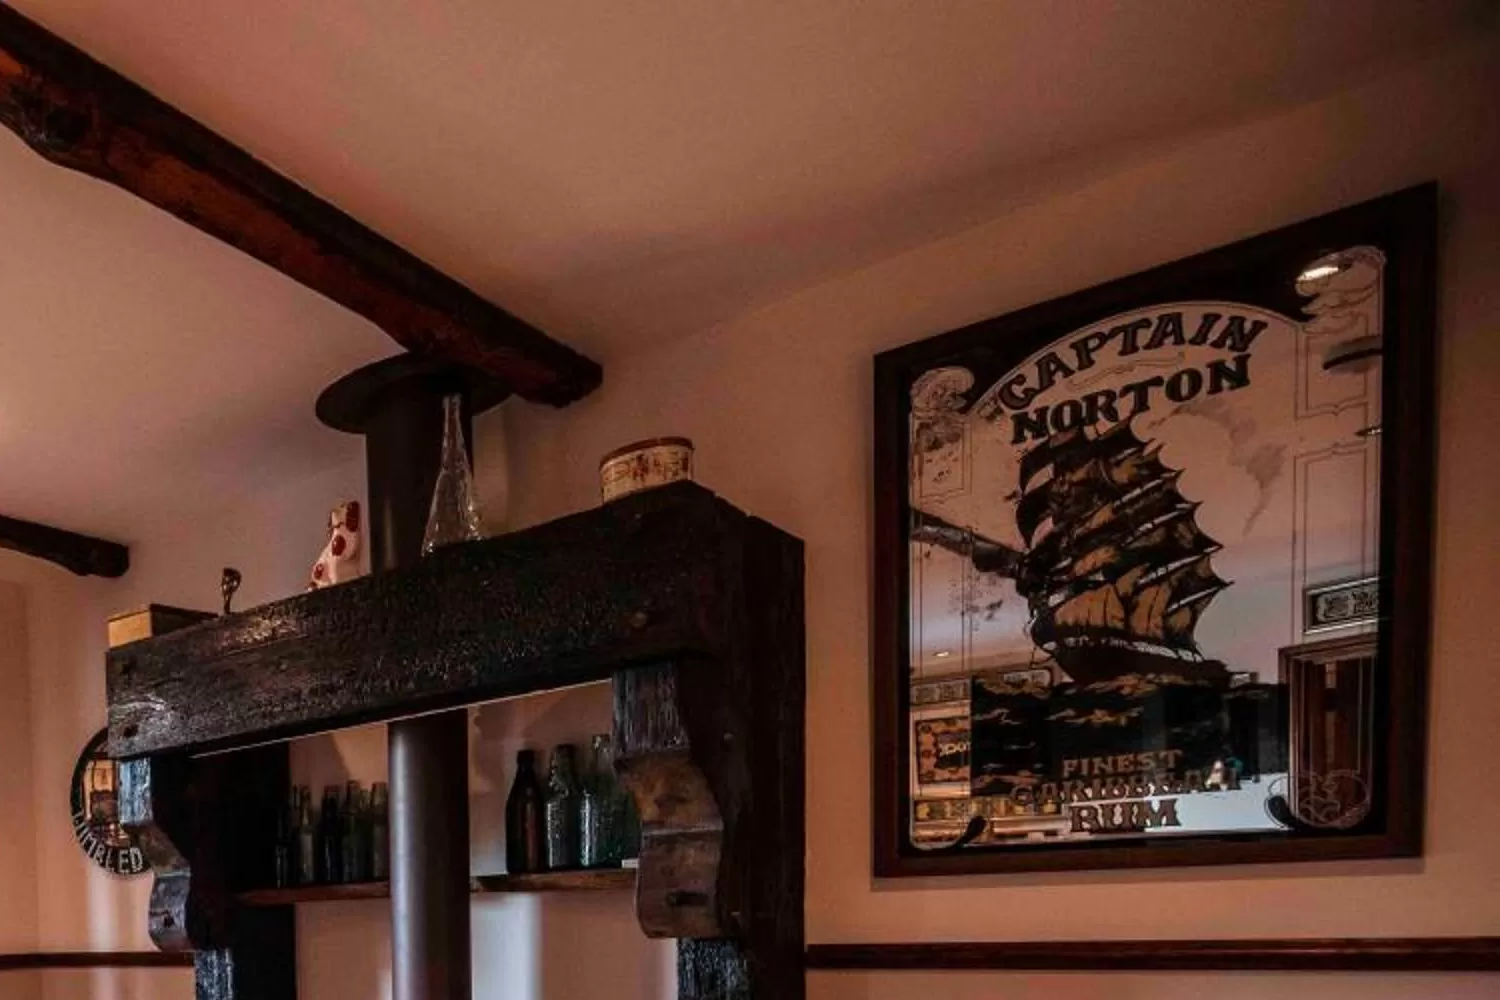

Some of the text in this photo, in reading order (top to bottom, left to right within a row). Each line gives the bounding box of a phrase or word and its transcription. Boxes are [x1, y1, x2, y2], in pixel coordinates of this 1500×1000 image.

[999, 311, 1268, 410] CAPTAIN
[1010, 353, 1252, 445] NORTON
[1062, 749, 1183, 778] FINEST
[1070, 798, 1183, 833] RUM
